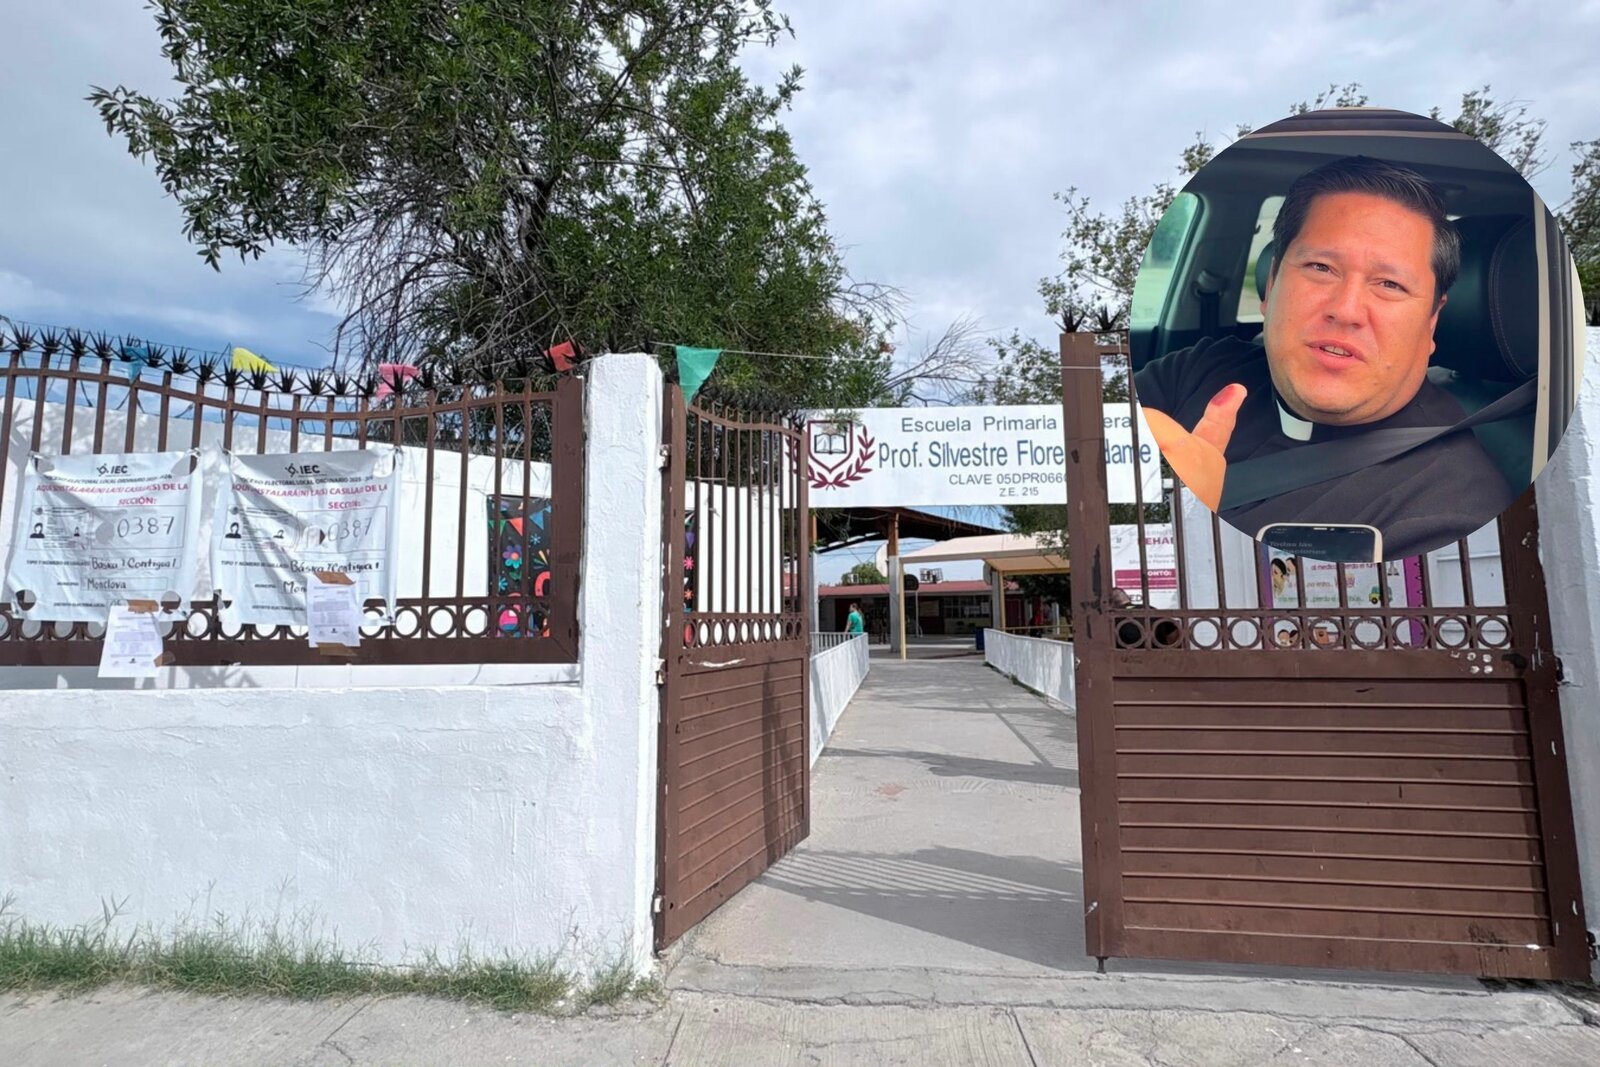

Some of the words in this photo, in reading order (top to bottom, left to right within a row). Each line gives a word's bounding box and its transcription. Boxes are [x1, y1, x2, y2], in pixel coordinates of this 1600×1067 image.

[901, 417, 971, 432] Escuela
[983, 415, 1057, 431] Primaria
[879, 441, 922, 468] Prof.
[928, 441, 1008, 467] Silvestre
[1017, 440, 1066, 466] Flore
[111, 465, 128, 474] IEC
[300, 465, 320, 474] IEC
[949, 474, 992, 485] CLAVE
[996, 472, 1067, 484] 05DPR066
[1022, 487, 1039, 496] 215
[117, 516, 175, 538] 0387
[328, 517, 372, 542] 0387
[87, 578, 127, 590] Monclova
